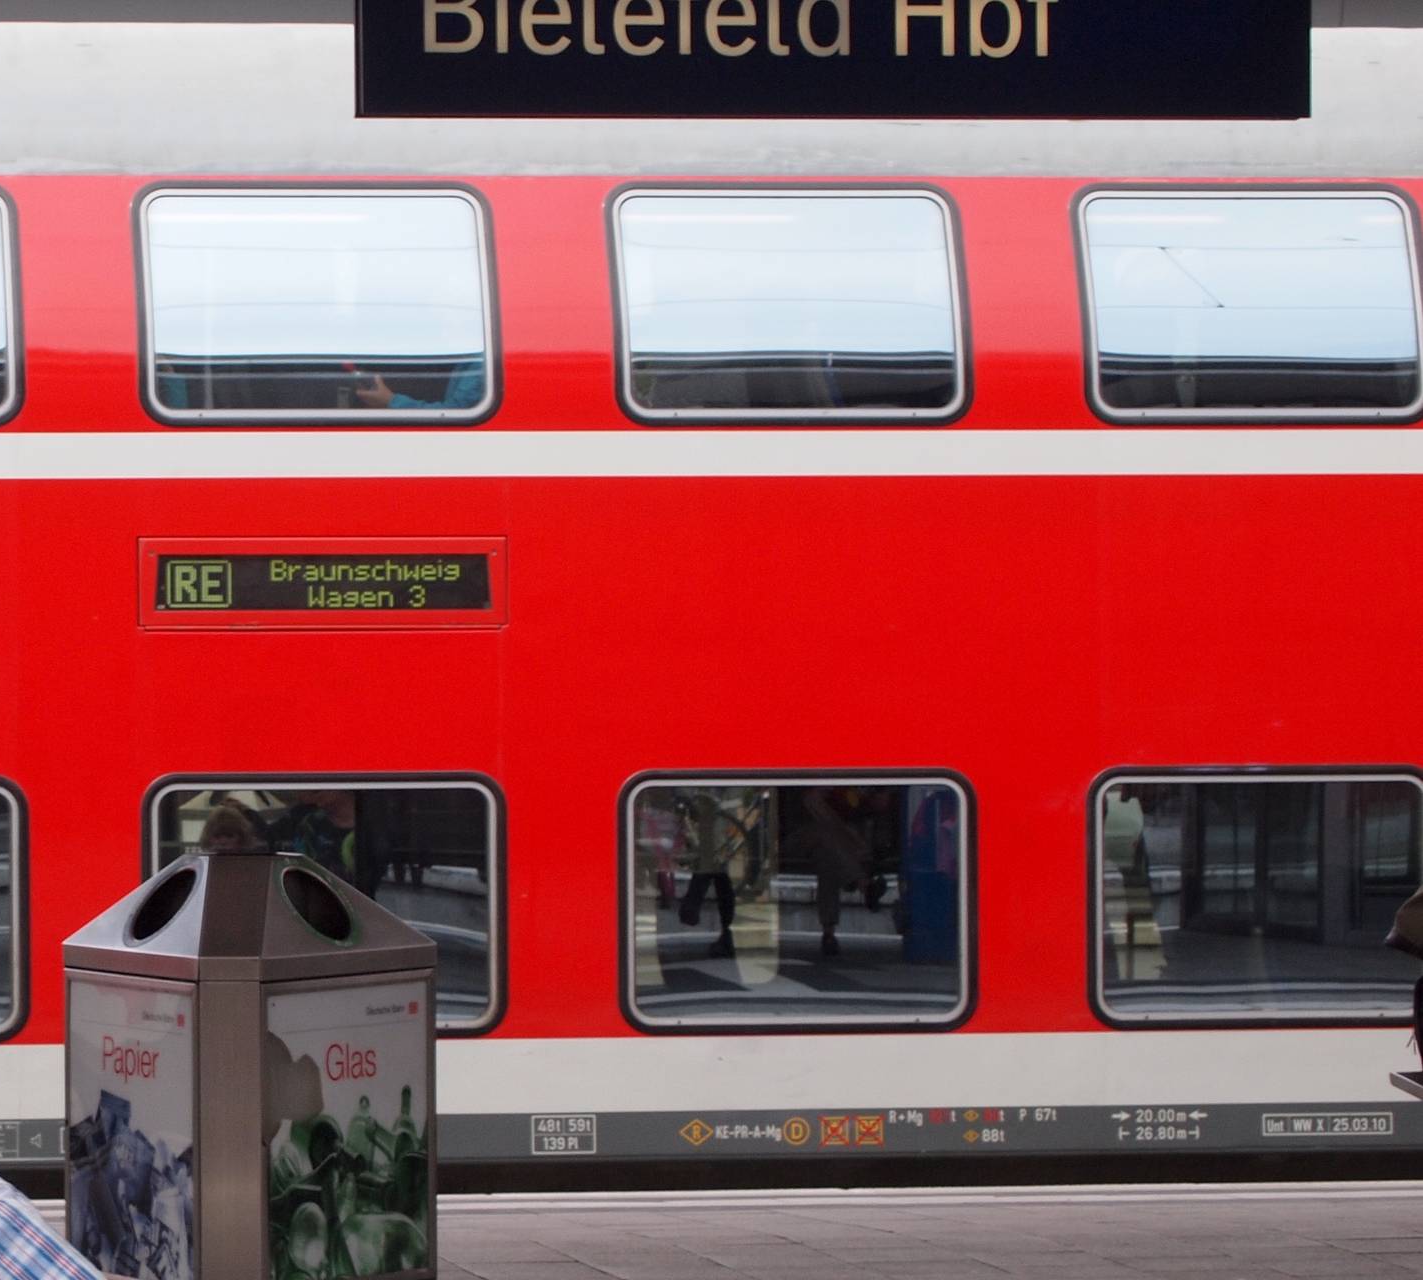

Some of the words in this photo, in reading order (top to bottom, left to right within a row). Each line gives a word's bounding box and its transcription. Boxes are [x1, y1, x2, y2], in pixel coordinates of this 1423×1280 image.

[895, 0, 1059, 58] Hbf
[270, 560, 461, 582] Braunschweig
[174, 565, 225, 603] RE
[307, 586, 394, 608] Wagen
[408, 585, 426, 607] 3
[103, 1036, 160, 1082] Papier
[325, 1043, 377, 1082] Glas
[538, 1118, 561, 1132] 48t
[568, 1118, 591, 1132] 59t
[791, 1122, 802, 1139] D
[1316, 1118, 1325, 1132] X
[1333, 1117, 1386, 1132] 25.03.10
[543, 1136, 566, 1150] 139
